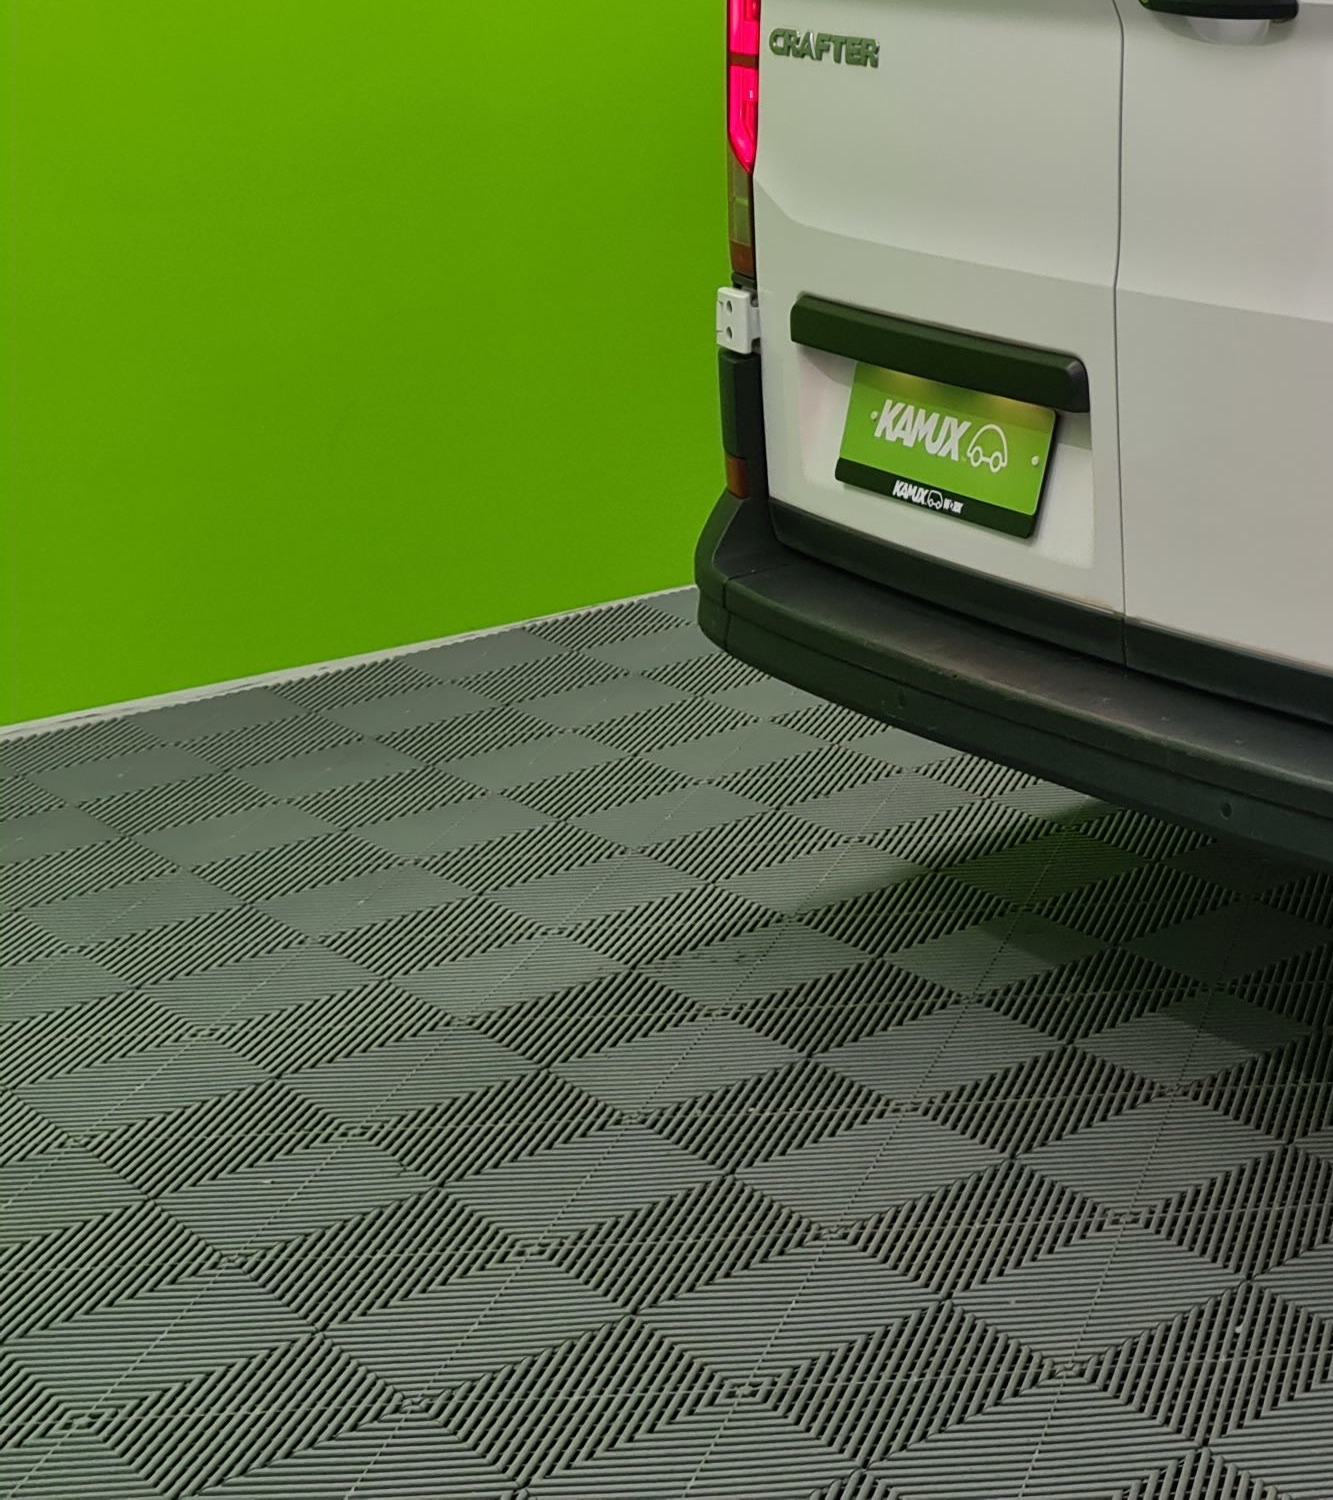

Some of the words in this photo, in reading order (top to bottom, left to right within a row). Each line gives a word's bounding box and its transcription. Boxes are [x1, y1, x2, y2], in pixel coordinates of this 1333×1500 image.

[769, 28, 880, 68] CRAFTER
[874, 399, 971, 462] KAMUX
[892, 480, 929, 505] KAMUX
